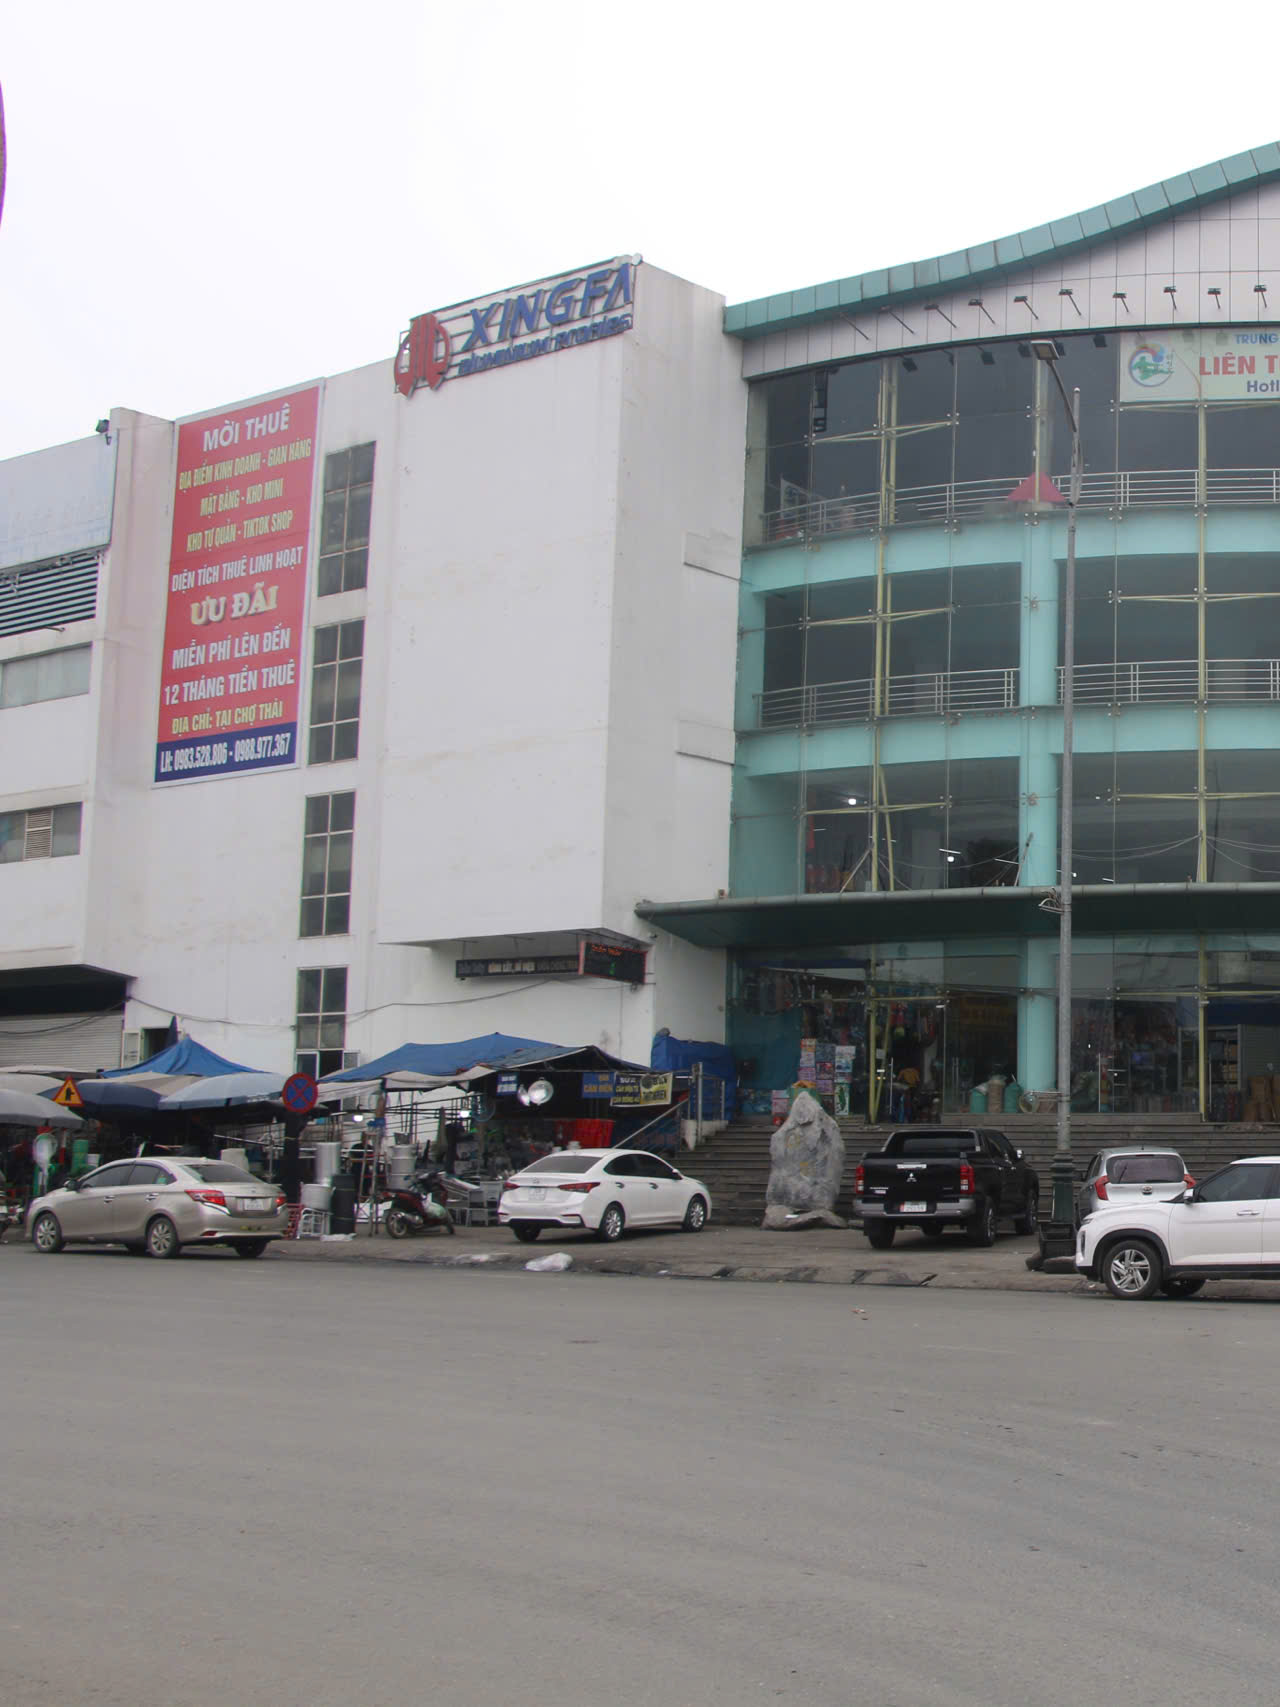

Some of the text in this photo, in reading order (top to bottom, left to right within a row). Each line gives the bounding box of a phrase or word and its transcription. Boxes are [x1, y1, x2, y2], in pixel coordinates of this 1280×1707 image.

[460, 263, 632, 350] XINGFA
[1234, 333, 1279, 345] TRUNG
[1199, 352, 1256, 376] LIÊN
[203, 402, 291, 452] MỜI THUÊ
[214, 460, 233, 481] KINH
[234, 452, 261, 476] DOANH
[268, 445, 287, 467] GIAN
[246, 483, 263, 505] KHO
[264, 478, 284, 500] MINI
[186, 532, 203, 552] KHO
[243, 515, 270, 539] TIKTOK
[271, 509, 293, 533] SHOP
[172, 546, 304, 594] DIỆN TÍCH THUÊ LINH HOẠT
[190, 582, 279, 626] ƯU ĐÃI
[172, 623, 291, 670] MIỄN PHÍ LÊN ĐẾN
[164, 659, 296, 706] 12 THÁNG TIỀN THUÊ
[172, 698, 283, 737] ĐỊA CHỈ: TẠI CHỢ THÁI
[160, 750, 173, 773] LH:
[174, 742, 228, 771] 0983.528.806
[234, 732, 291, 763] 0988.977.367
